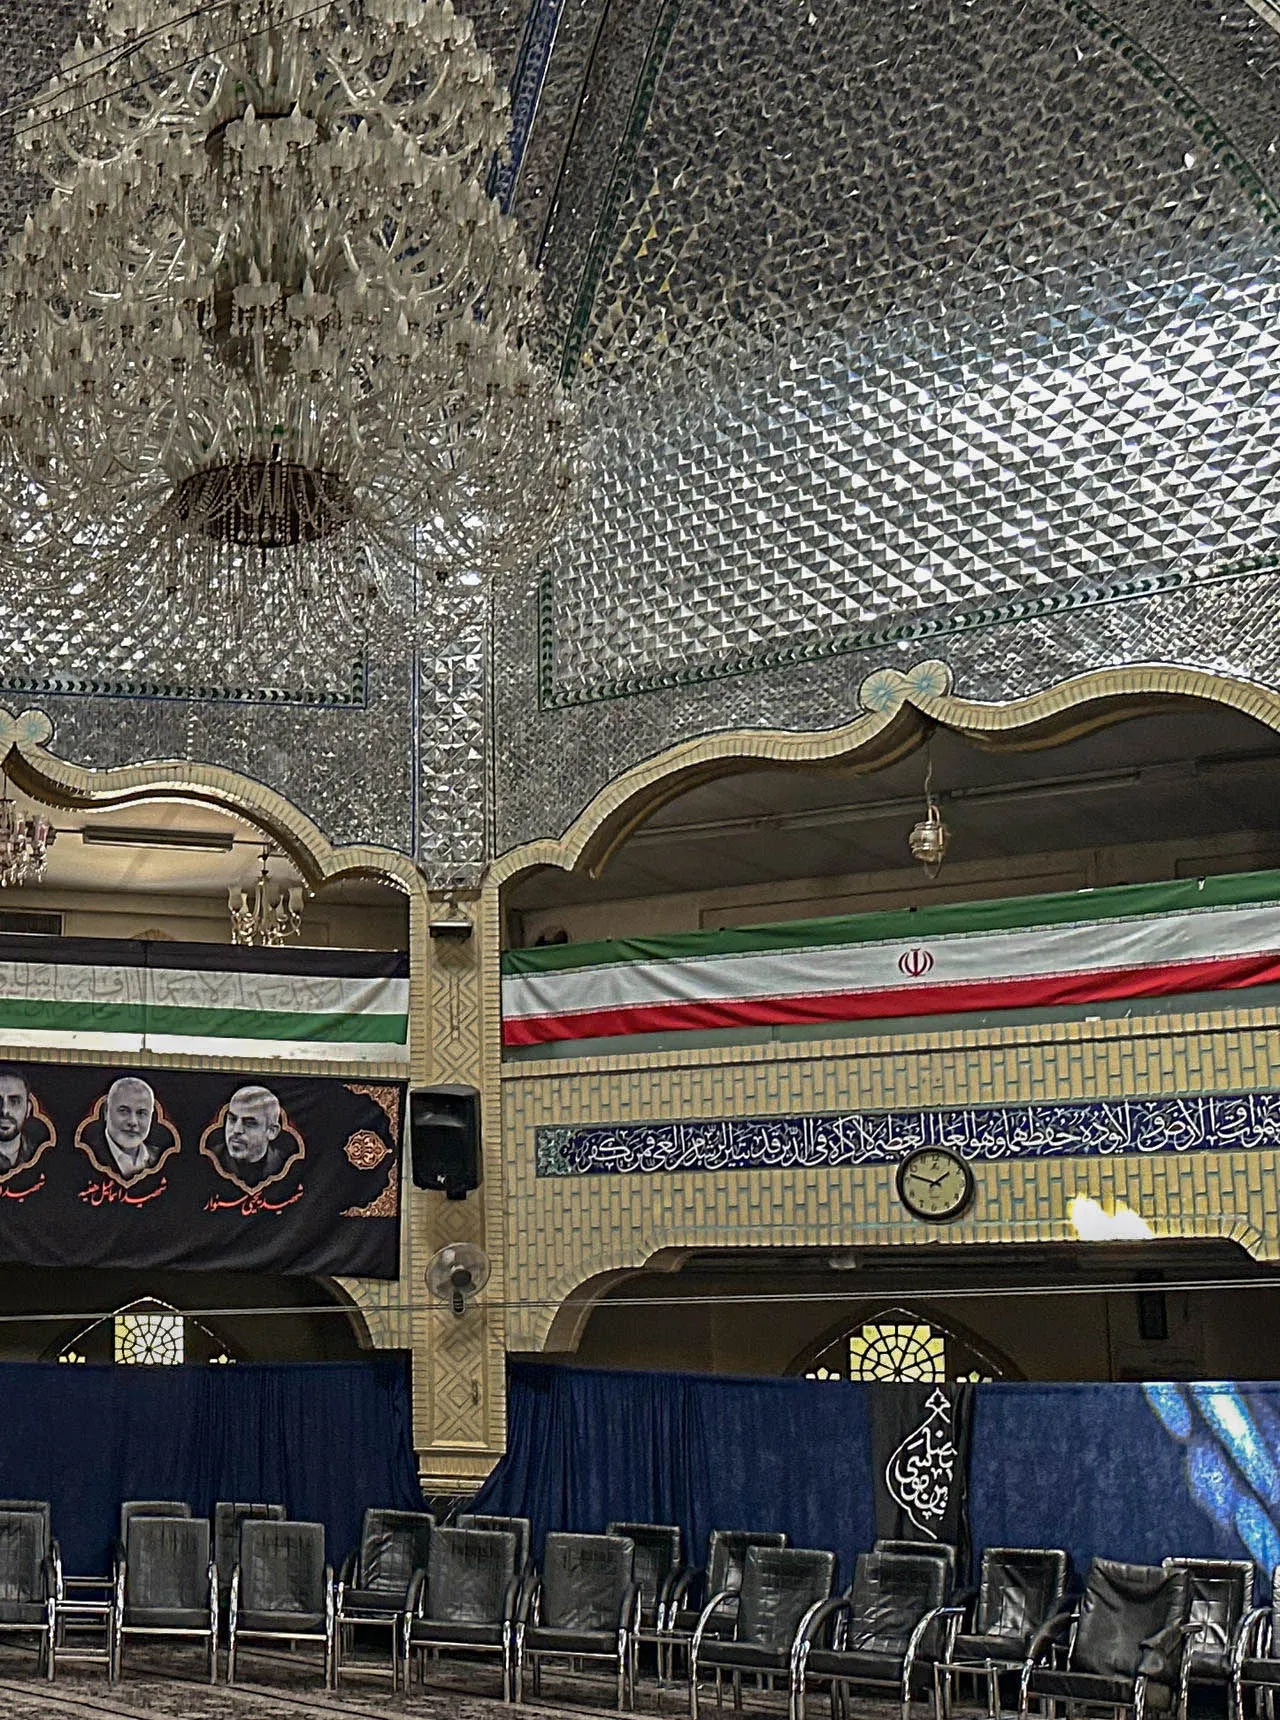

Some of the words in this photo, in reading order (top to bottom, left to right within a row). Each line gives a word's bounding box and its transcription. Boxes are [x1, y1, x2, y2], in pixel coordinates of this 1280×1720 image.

[1, 1173, 45, 1202] شهید
[121, 1177, 167, 1208] شهید
[260, 1184, 303, 1214] شهید
